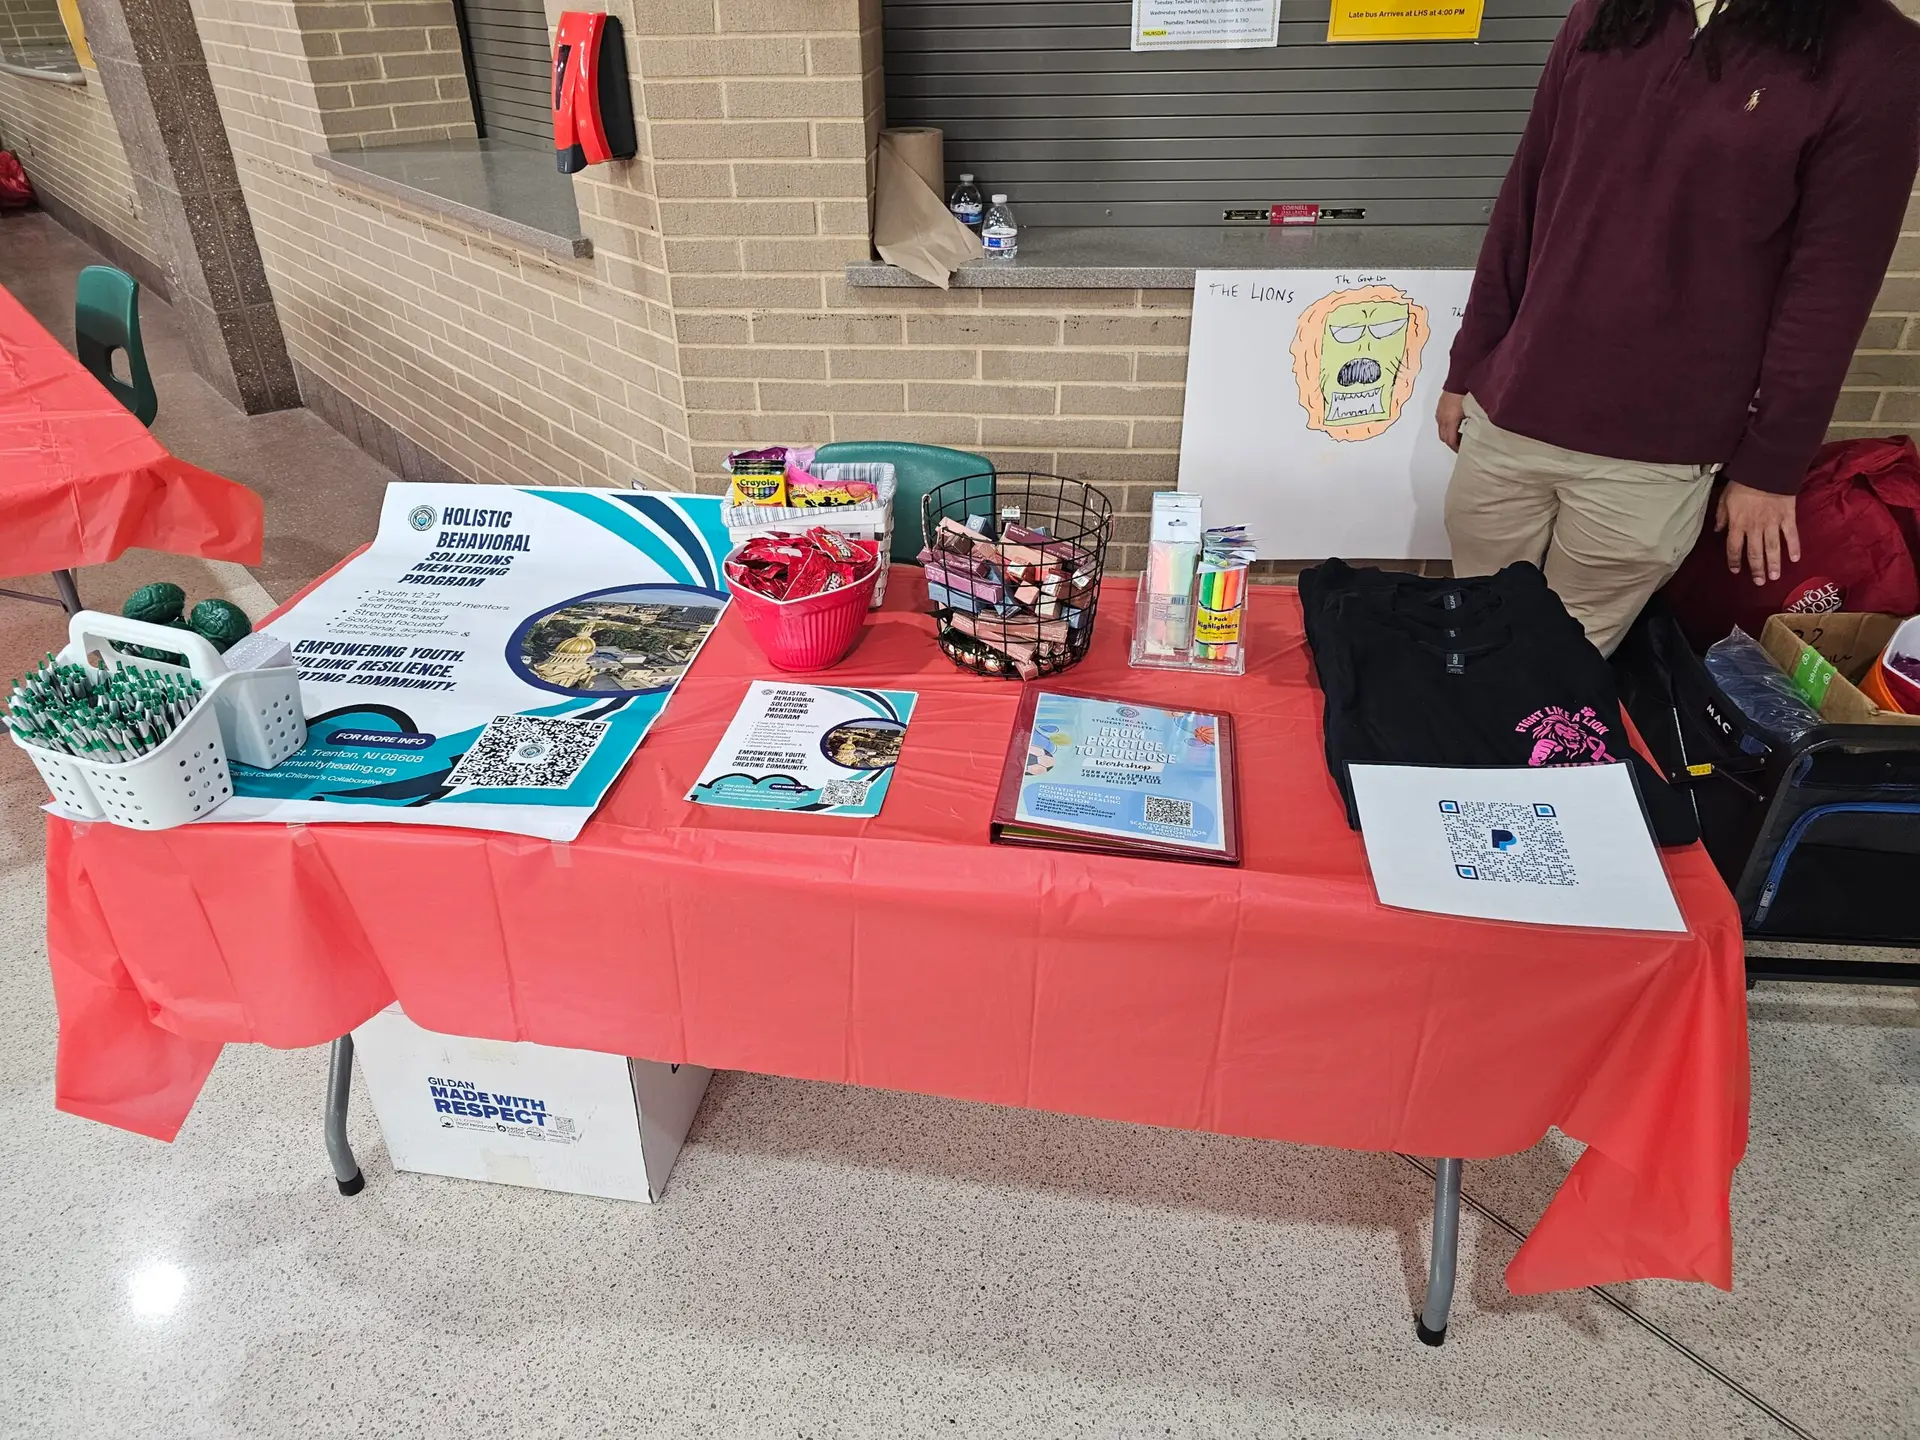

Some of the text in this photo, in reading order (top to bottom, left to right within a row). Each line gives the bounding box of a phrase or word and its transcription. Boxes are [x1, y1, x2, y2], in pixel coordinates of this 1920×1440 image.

[1209, 282, 1294, 303] THE LIONS
[740, 479, 775, 487] Crayola
[442, 507, 512, 528] HOLISTIC
[436, 532, 531, 552] BEHAVIORAL
[425, 552, 514, 565] SOLUTIONS
[411, 563, 510, 576] MENTORING
[397, 574, 486, 587] PROGRAM
[377, 589, 408, 597] Youth
[1787, 582, 1839, 613] WHOLE
[368, 596, 417, 605] Certified,
[461, 602, 510, 610] mentors
[384, 604, 440, 614] therapists
[1803, 593, 1840, 613] OODS
[353, 608, 408, 619] Strengths
[345, 616, 392, 625] Solution
[1198, 621, 1238, 630] Highlighters
[337, 622, 396, 632] Emotional,
[400, 628, 458, 636] academic
[293, 639, 465, 662] EMPOWERING YOUTH.
[292, 656, 454, 678] UILDING RESILIENCE.
[296, 671, 457, 692] ATING COMMUNITY.
[1515, 706, 1610, 735] FIGHT LIKE A LION
[1706, 703, 1733, 734] MAC
[336, 732, 361, 740] FOR
[363, 735, 398, 743] MORE
[1100, 726, 1145, 740] FROM
[1085, 736, 1164, 752] PRACTICE
[311, 749, 359, 760] Trenton,
[363, 751, 378, 760] NJ
[382, 753, 425, 763] 08608
[738, 749, 783, 757] EMPOWERING
[1075, 745, 1177, 764] TO PURPOSE
[766, 763, 808, 771] COMMUNITY.
[286, 772, 327, 780] Children's
[328, 775, 382, 785] Collaborative
[1040, 784, 1074, 793] HOLISTIC
[1038, 793, 1089, 804] FOUNDATION
[1039, 789, 1121, 804] COMMUNITY HEALING
[1035, 807, 1079, 816] development
[1076, 807, 1116, 815] educational
[1151, 831, 1185, 839] PROGRAM
[1155, 828, 1198, 837] MENTORSHIP
[427, 1077, 475, 1090] GILDAN
[430, 1086, 546, 1111] MADE WITH
